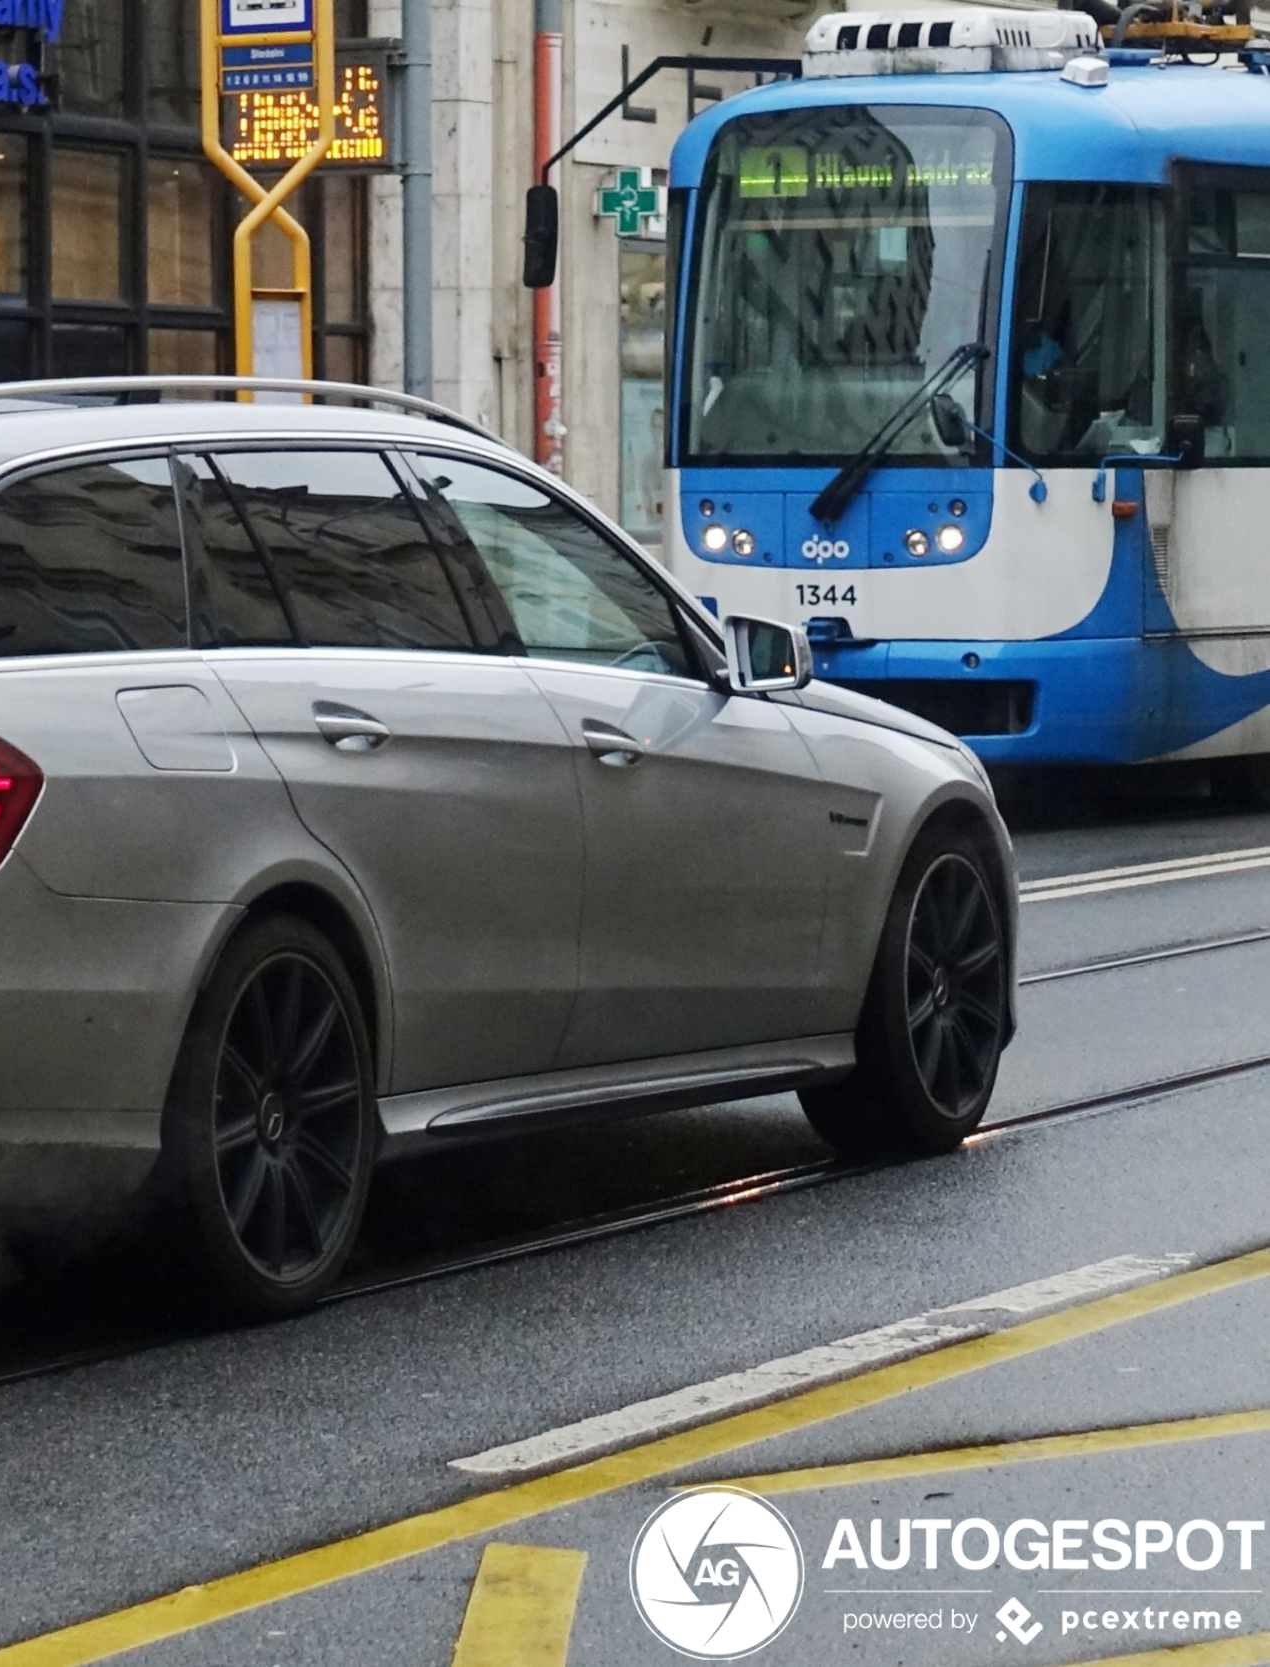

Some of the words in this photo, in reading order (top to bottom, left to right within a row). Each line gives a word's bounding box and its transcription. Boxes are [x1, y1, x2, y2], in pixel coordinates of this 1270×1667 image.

[766, 152, 781, 195] 1
[815, 152, 893, 188] Hlavní
[801, 534, 850, 565] dpo
[795, 584, 857, 606] 1344
